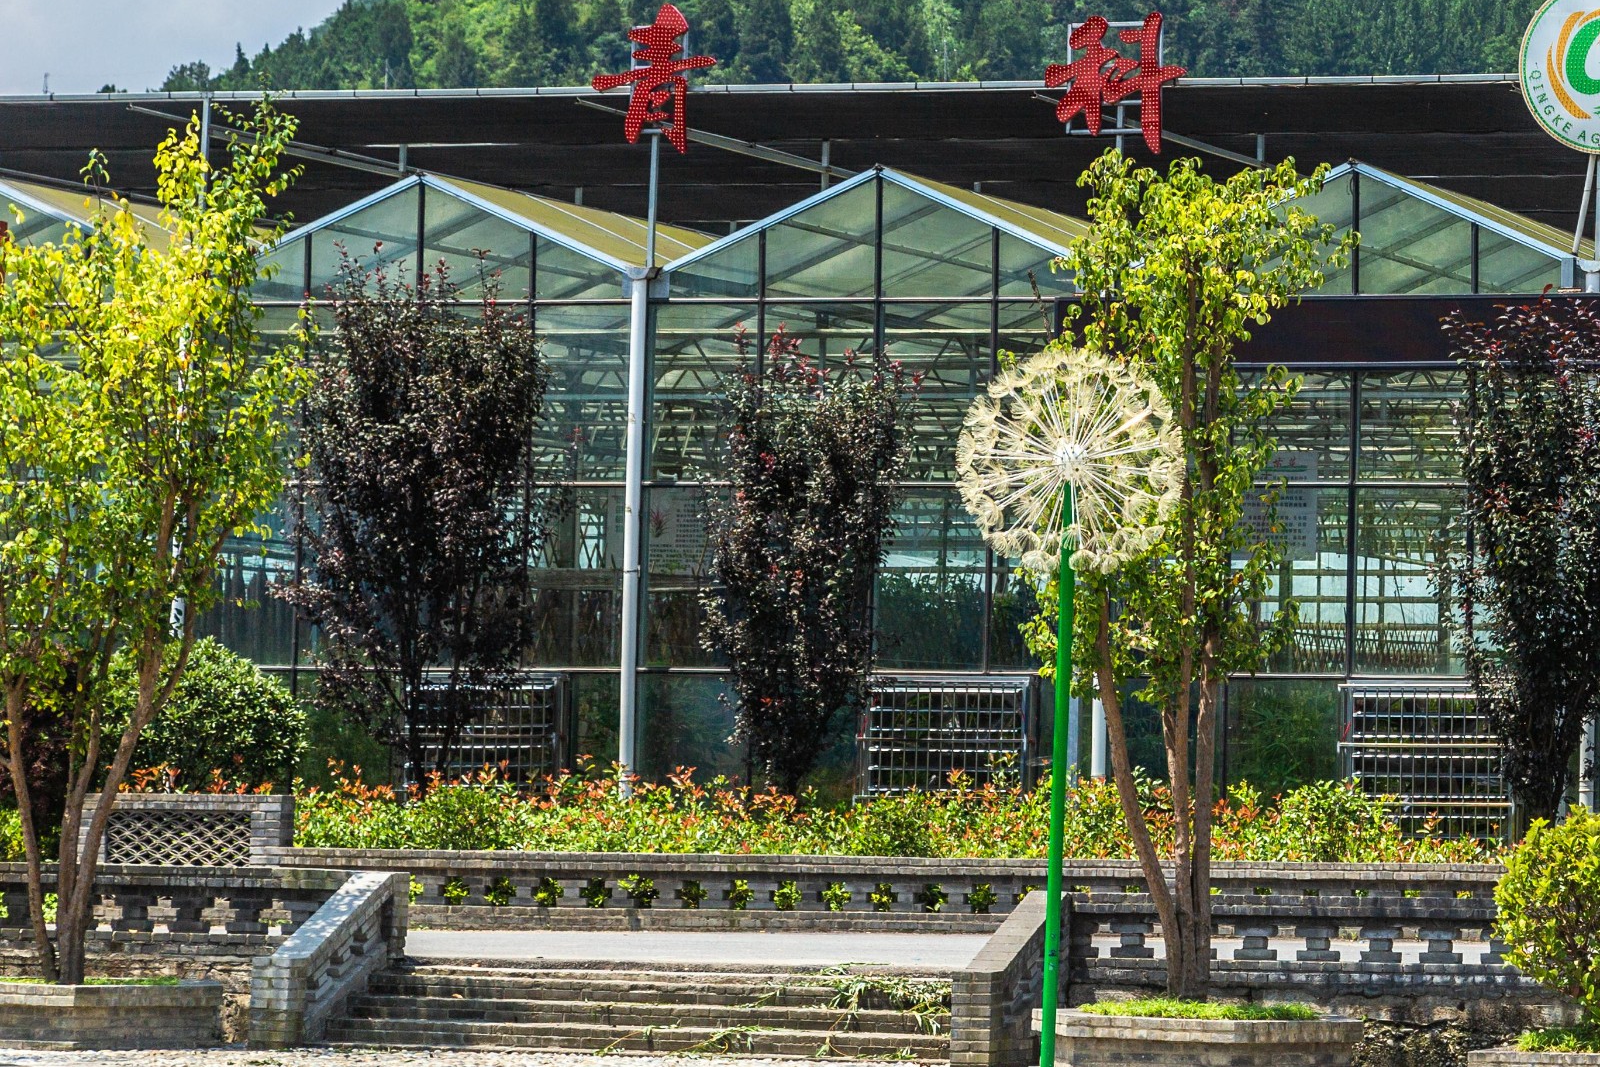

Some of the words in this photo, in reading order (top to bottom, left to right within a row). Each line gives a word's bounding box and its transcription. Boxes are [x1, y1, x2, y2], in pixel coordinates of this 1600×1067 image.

[591, 3, 717, 155] 青
[1044, 11, 1187, 155] 科
[1529, 69, 1573, 133] QINGKE
